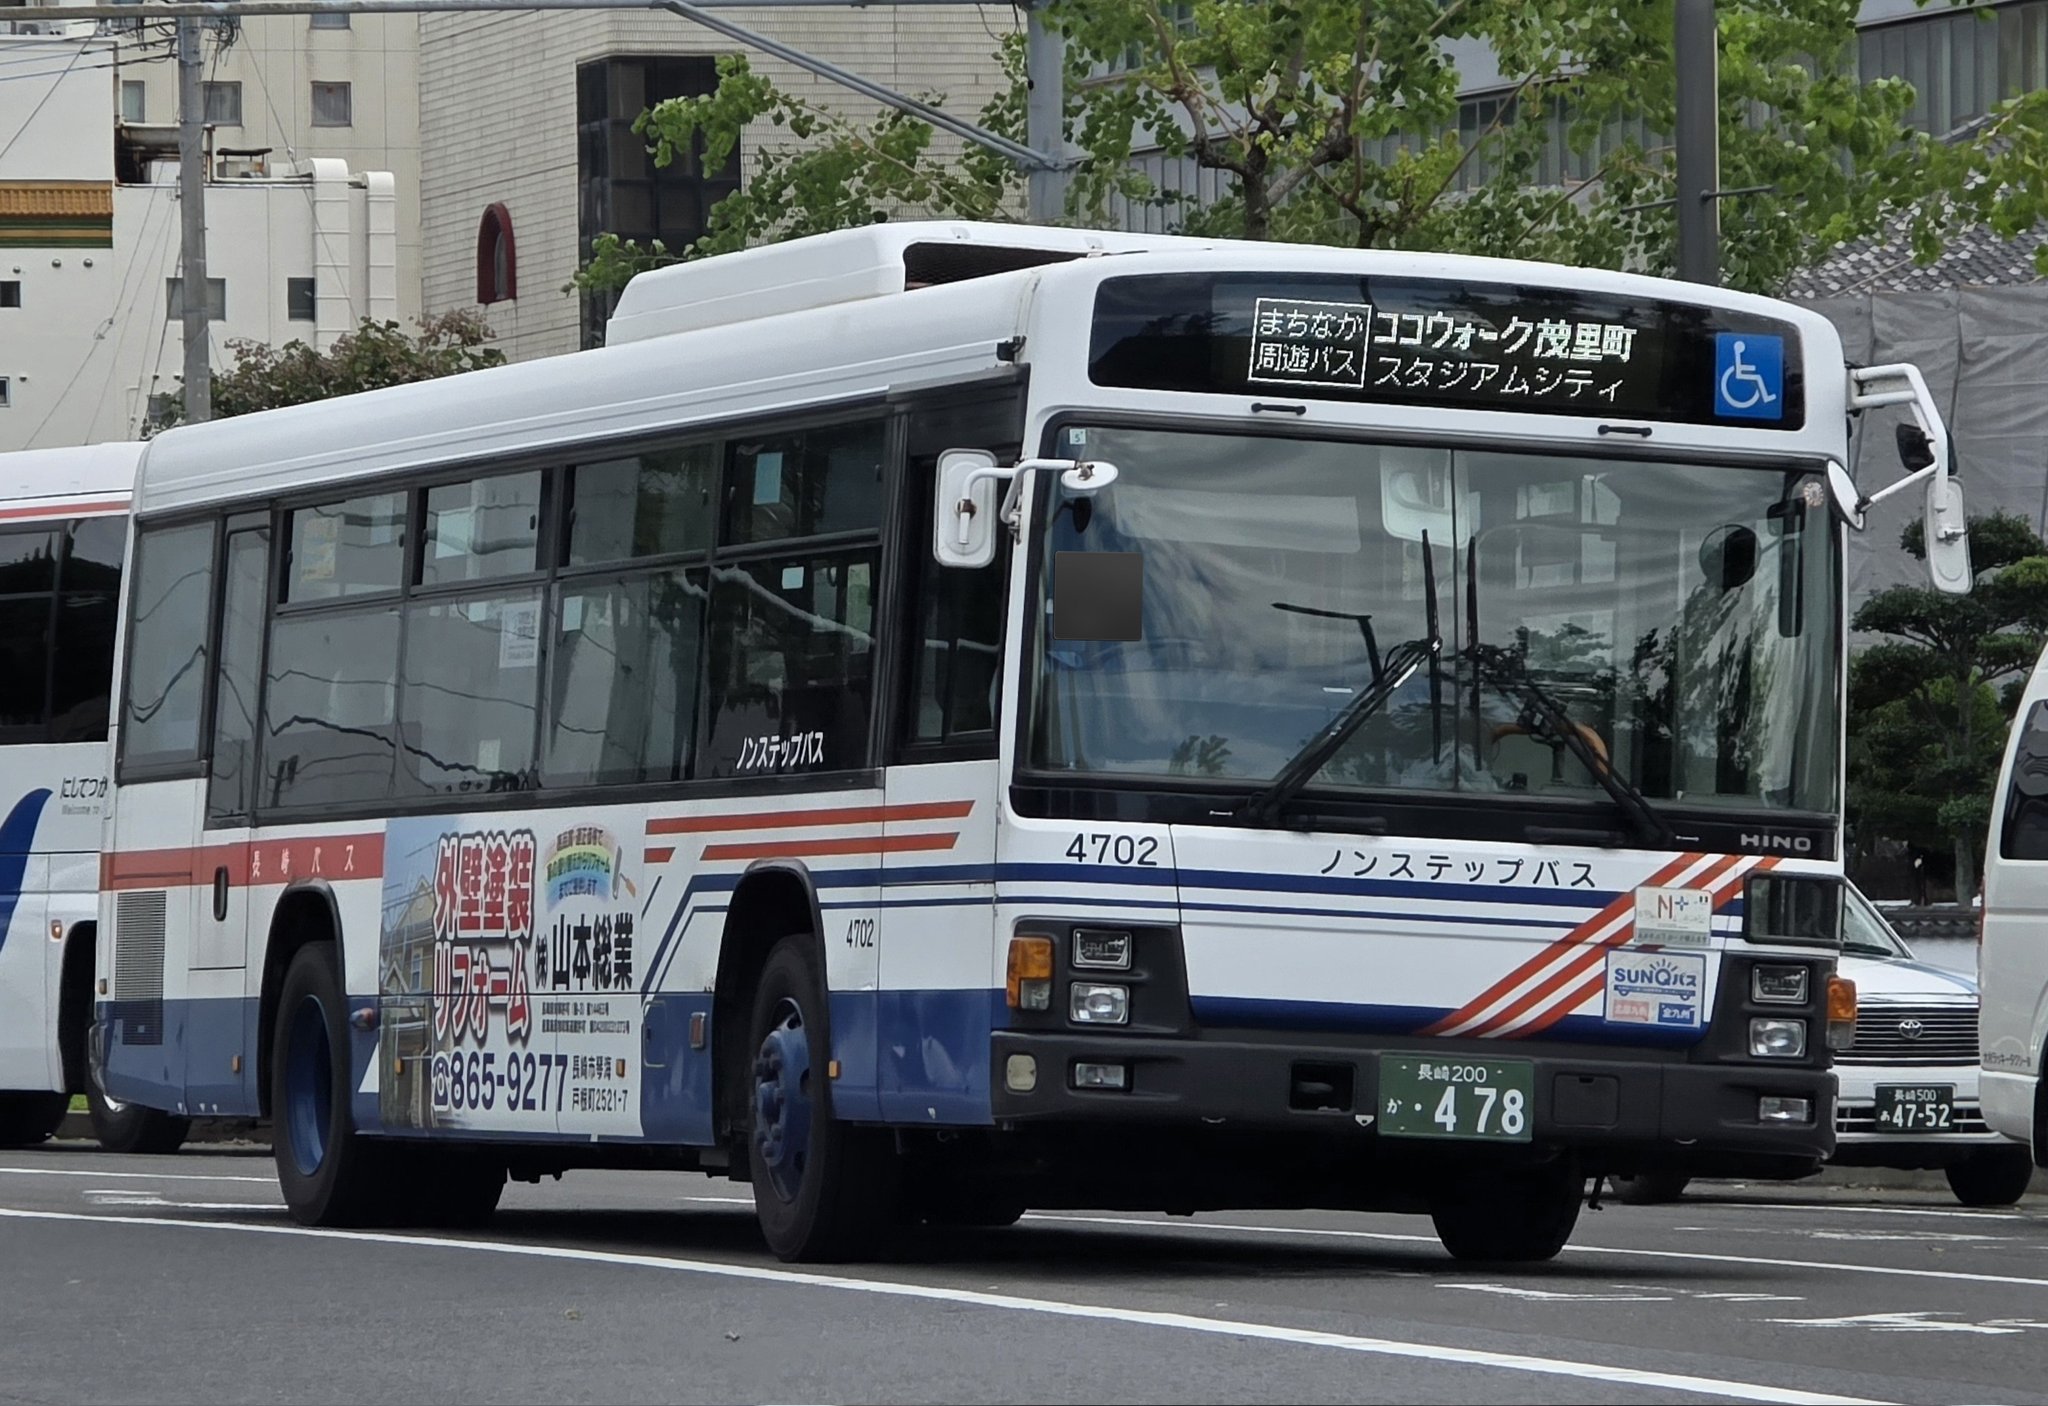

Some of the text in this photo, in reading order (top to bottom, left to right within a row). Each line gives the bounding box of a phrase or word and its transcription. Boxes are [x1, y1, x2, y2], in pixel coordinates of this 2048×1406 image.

[1259, 307, 1364, 341] まちなか
[1374, 311, 1637, 363] ココウォーク茂里町
[1255, 342, 1357, 377] 周遊バス
[1374, 356, 1623, 401] スタジアムシティ
[736, 730, 824, 770] ノンステップバス
[1066, 833, 1158, 866] 4702
[1741, 833, 1811, 851] HINO
[252, 844, 354, 878] 長崎バス
[1321, 850, 1595, 888] ノンステップバス
[433, 834, 534, 940] 外壁塗装
[846, 918, 875, 948] 4702
[433, 939, 530, 1040] リフォーム
[451, 1051, 568, 1112] 865-9277
[1386, 1098, 1402, 1114] か
[1892, 1103, 1950, 1127] 47-52
